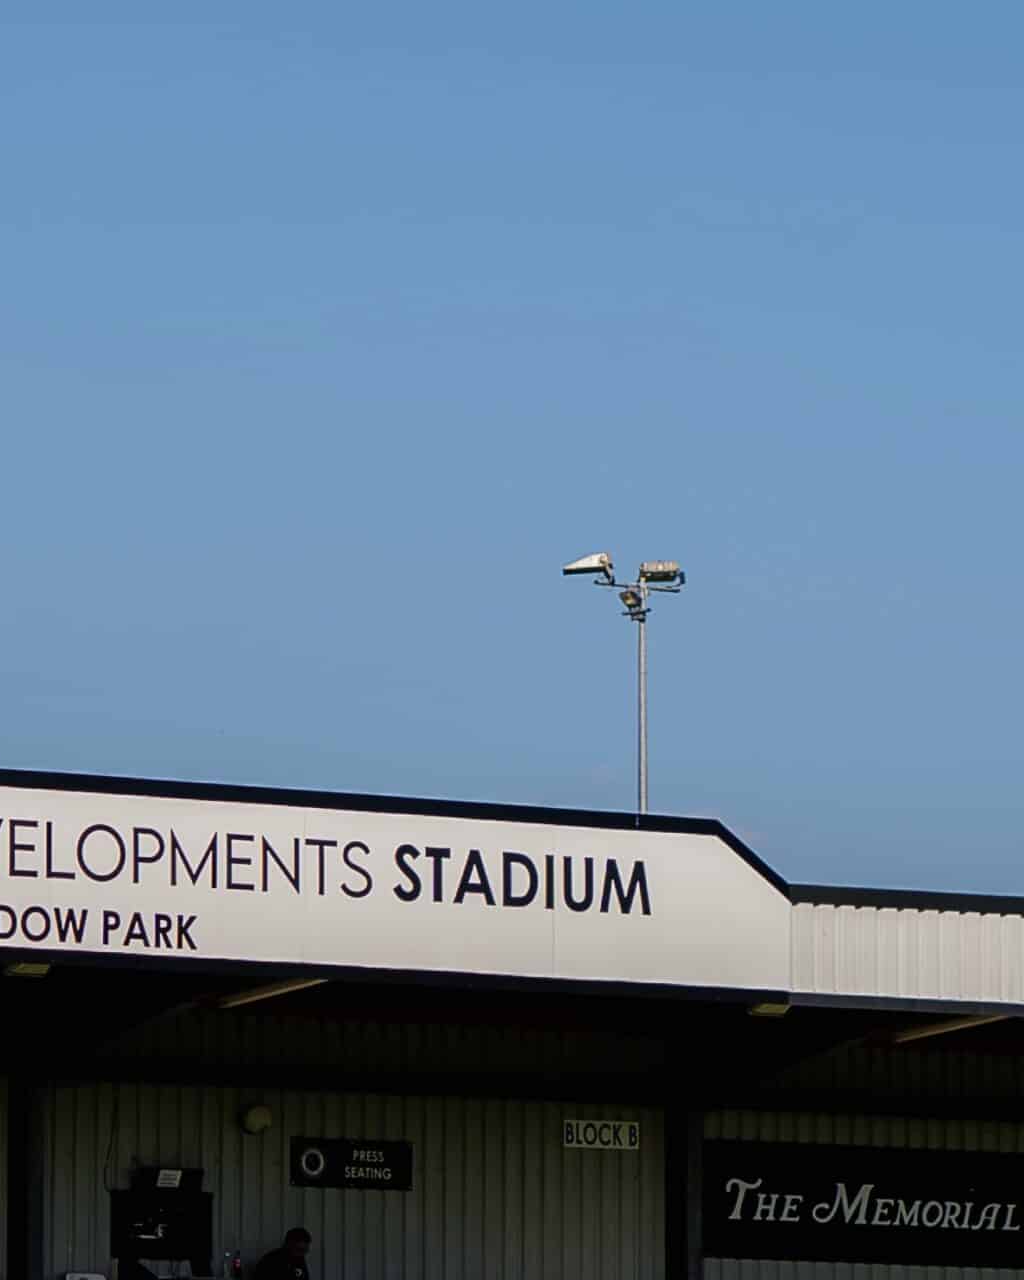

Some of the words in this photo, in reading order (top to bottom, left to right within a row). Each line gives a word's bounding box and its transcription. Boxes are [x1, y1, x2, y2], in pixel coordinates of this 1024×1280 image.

[392, 843, 652, 916] STADIUM
[102, 910, 197, 950] PARK
[565, 1122, 623, 1147] BLOCK
[629, 1124, 638, 1147] B
[352, 1149, 385, 1162] PRESS
[344, 1165, 393, 1180] SEATING
[726, 1177, 804, 1223] THE
[812, 1182, 1022, 1232] MEMORIAL
